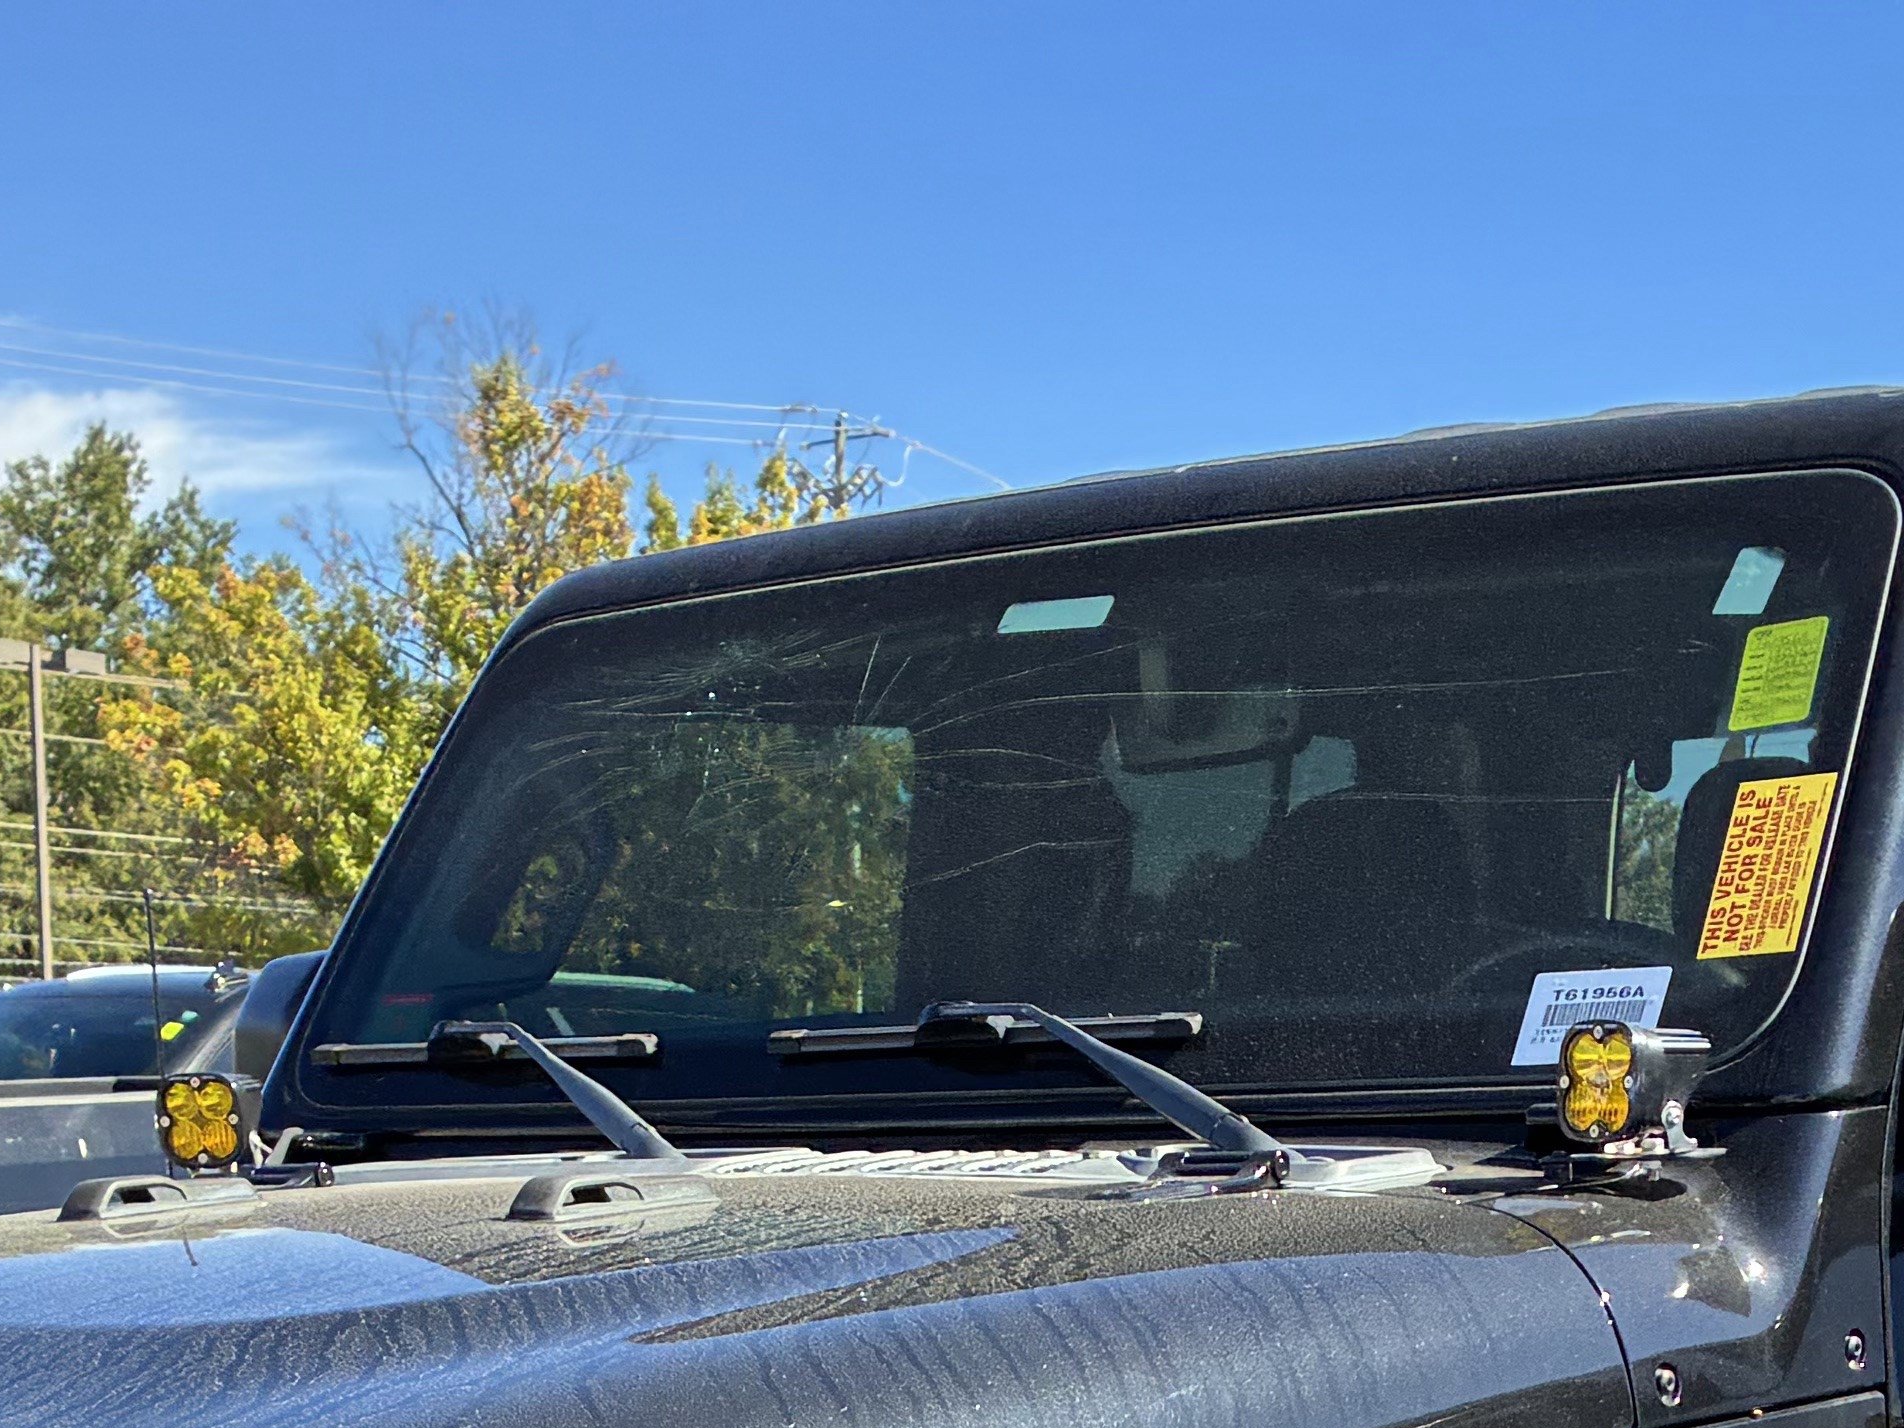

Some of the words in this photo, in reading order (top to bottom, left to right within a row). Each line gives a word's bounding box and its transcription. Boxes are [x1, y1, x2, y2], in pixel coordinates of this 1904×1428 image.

[1745, 796, 1773, 847] SALE
[1701, 906, 1727, 953] THIS
[1714, 814, 1750, 900] VEHICLE
[1737, 789, 1756, 807] IS
[1733, 853, 1759, 894] FOR
[1722, 900, 1747, 942] NOT
